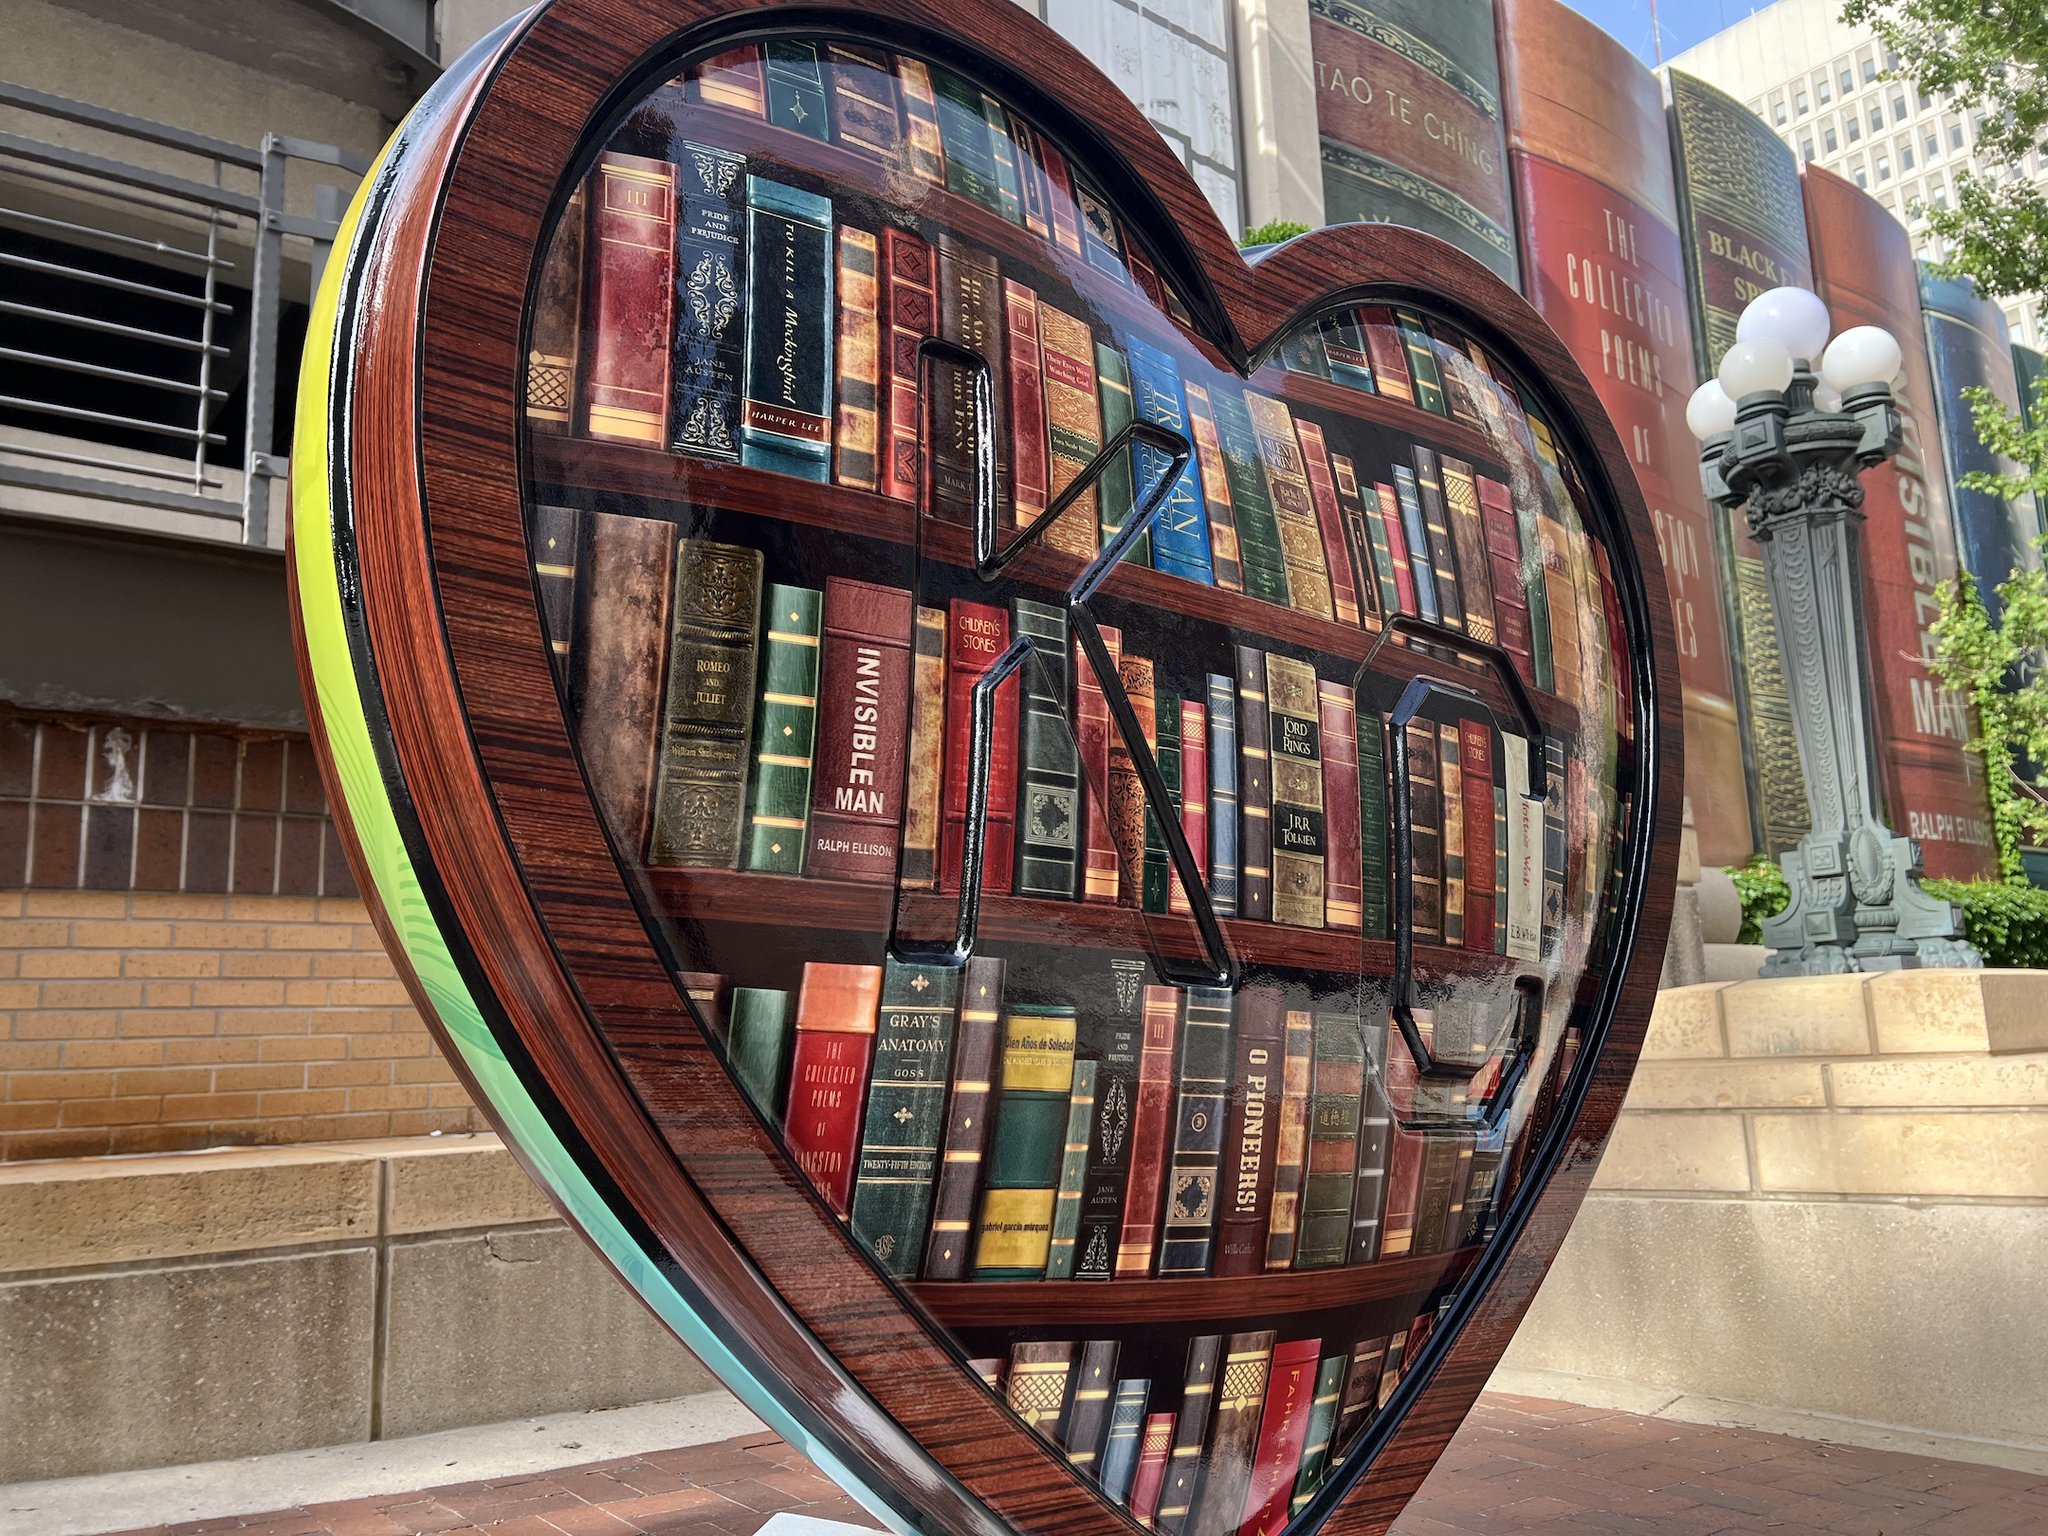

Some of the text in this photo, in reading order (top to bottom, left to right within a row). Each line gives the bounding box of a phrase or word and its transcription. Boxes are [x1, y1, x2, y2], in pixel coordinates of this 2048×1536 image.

[1315, 61, 1494, 175] TAO TE CHING
[701, 208, 730, 223] PRIDE
[704, 221, 726, 231] AND
[785, 223, 794, 241] TO
[691, 227, 739, 245] PREJUDICE
[1603, 208, 1640, 267] THE
[785, 246, 795, 282] KILL
[1707, 230, 1778, 283] BLACK
[1566, 253, 1674, 347] COLLECTED
[694, 356, 726, 370] JANE
[777, 305, 798, 404] Mockingbird
[1601, 329, 1664, 398] POEMS
[684, 366, 734, 382] AUSTEN
[751, 410, 821, 434] HARPER LEE
[1263, 438, 1294, 458] SILENT
[1633, 424, 1650, 466] OF
[1266, 452, 1299, 473] SPRING
[959, 615, 1001, 637] CHILDREN'S
[963, 634, 996, 654] STORIES
[696, 660, 730, 673] ROMEO
[704, 678, 719, 687] AND
[694, 691, 726, 705] JULIET
[849, 647, 881, 786] INVISIBLE
[1910, 677, 1968, 741] MAN
[1283, 716, 1308, 737] LORD
[1283, 736, 1311, 755] RINGS
[835, 787, 884, 814] MAN
[1909, 810, 1955, 842] RALPH
[1282, 828, 1316, 846] TOLKIEN
[817, 839, 892, 857] RALPH ELLISON
[890, 1015, 940, 1029] GRAY'S
[879, 1039, 946, 1052] ANATOMY
[1005, 1035, 1074, 1051] Cien Años de Soledad
[1115, 1032, 1131, 1041] PRIDE
[826, 1042, 843, 1060] THE
[805, 1064, 856, 1084] COLLECTED
[894, 1068, 924, 1078] GOSS
[811, 1090, 841, 1108] POEMS
[816, 1122, 826, 1136] OF
[1235, 1048, 1269, 1213] O PIONEERS!
[1097, 1185, 1115, 1194] JANE
[1091, 1195, 1117, 1204] AUSTEN
[1263, 1370, 1300, 1520] FAHRENHEIT
